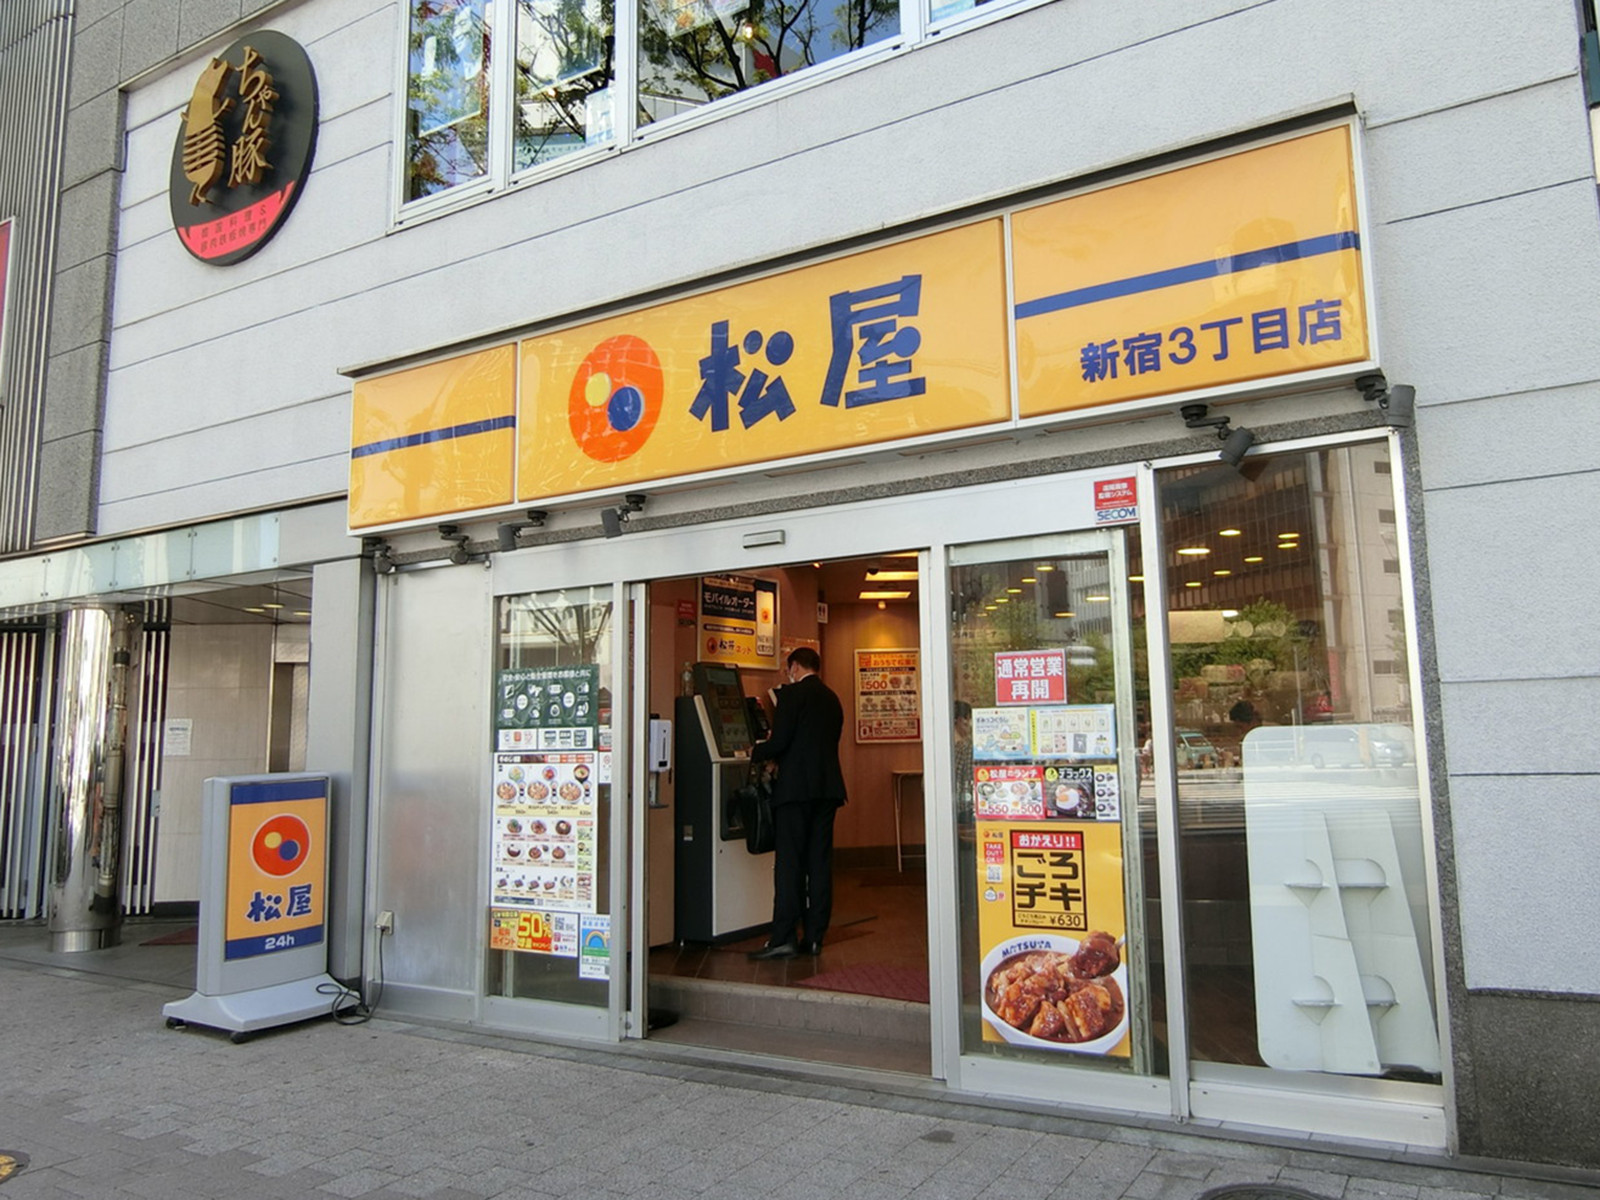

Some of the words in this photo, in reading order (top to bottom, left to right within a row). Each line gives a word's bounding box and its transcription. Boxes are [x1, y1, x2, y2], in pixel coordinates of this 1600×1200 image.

[228, 45, 277, 188] ちゃん豚
[1080, 299, 1342, 383] 新宿3丁目店
[689, 274, 926, 432] 松屋
[1097, 508, 1136, 521] SECOM
[704, 591, 755, 608] モバイルオーダー
[997, 656, 1063, 679] 通常営業
[1010, 679, 1050, 700] 再開
[989, 769, 1038, 779] 松屋のランチ
[1058, 767, 1093, 779] デラックス
[1021, 804, 1042, 814] 500
[1019, 834, 1076, 848] おかえり!!
[1017, 852, 1079, 880] ごろ
[247, 884, 313, 922] 松屋
[1016, 882, 1082, 911] チキ
[1049, 915, 1082, 927] ¥630
[265, 935, 295, 950] 24h
[1002, 940, 1052, 958] MATSUYA
